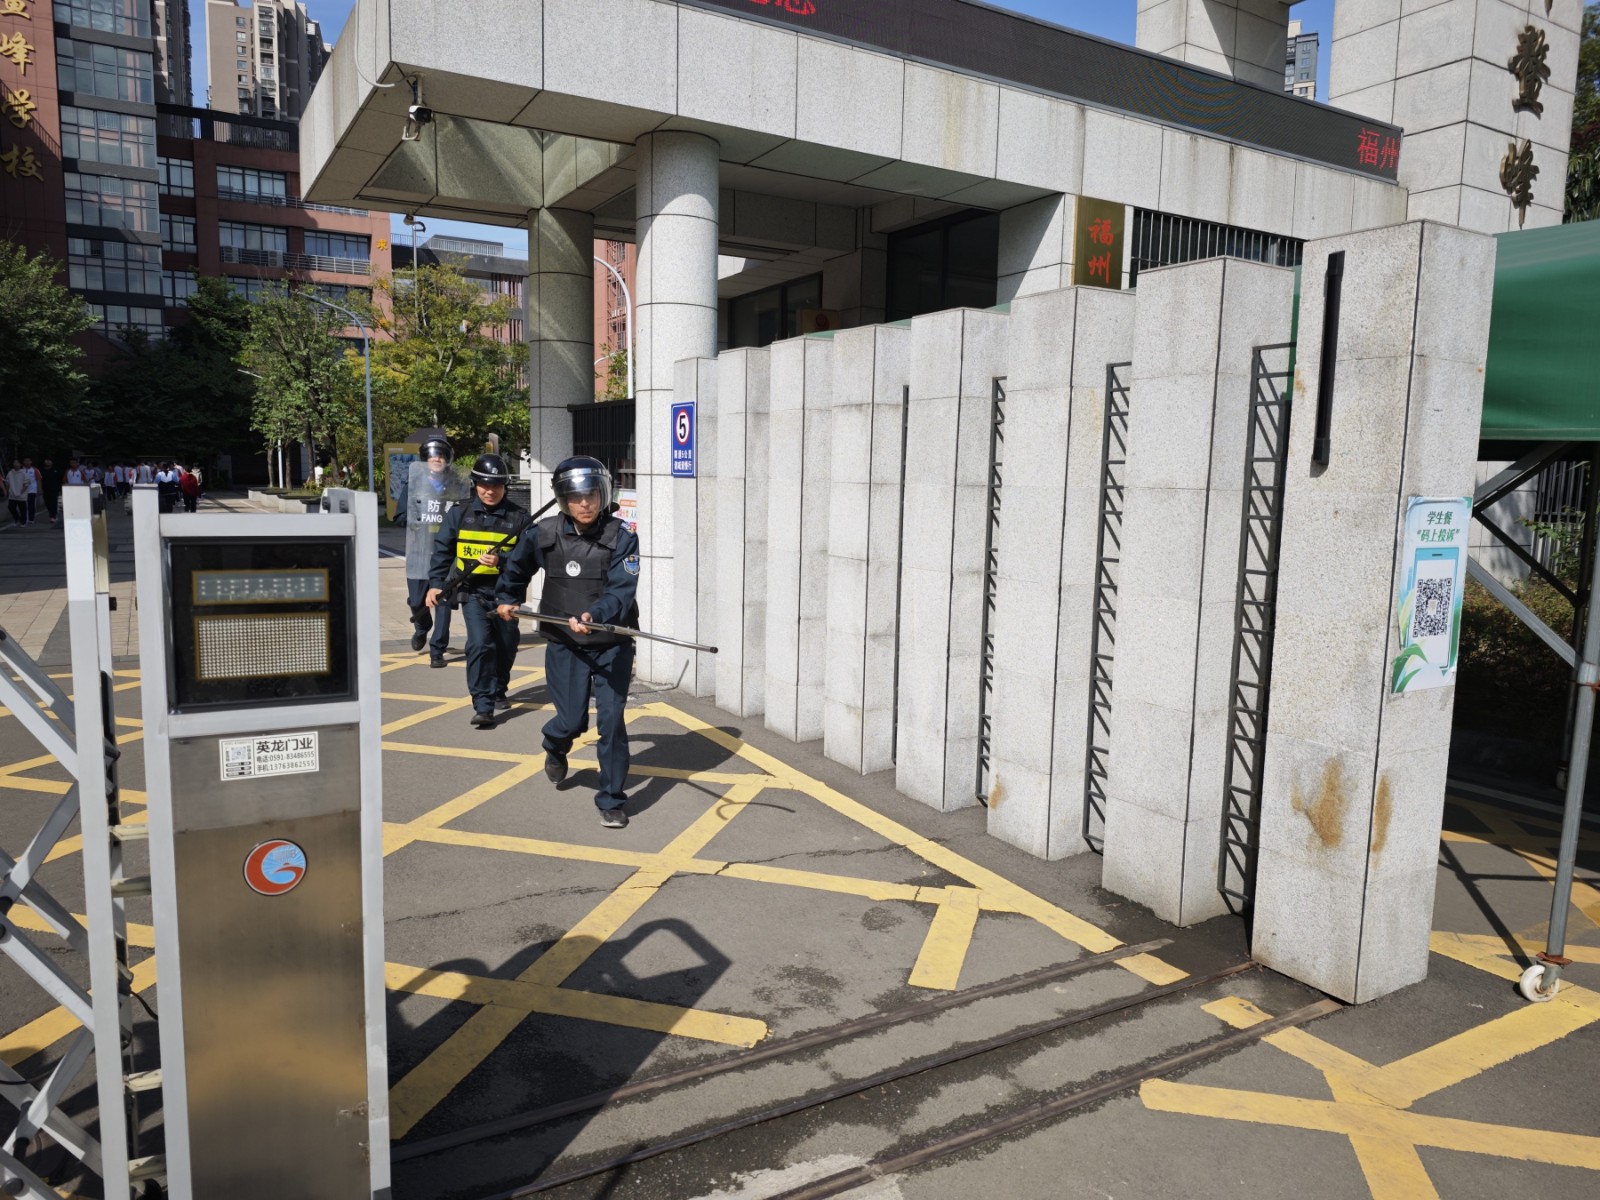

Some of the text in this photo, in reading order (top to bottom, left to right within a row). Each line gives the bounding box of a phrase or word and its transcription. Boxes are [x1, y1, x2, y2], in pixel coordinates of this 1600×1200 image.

[1357, 127, 1399, 170] 福州
[1087, 217, 1114, 285] 福州
[679, 414, 687, 440] 5
[421, 513, 443, 523] FANG
[1426, 510, 1453, 525] 学生餐
[256, 737, 313, 754] 英龙门业
